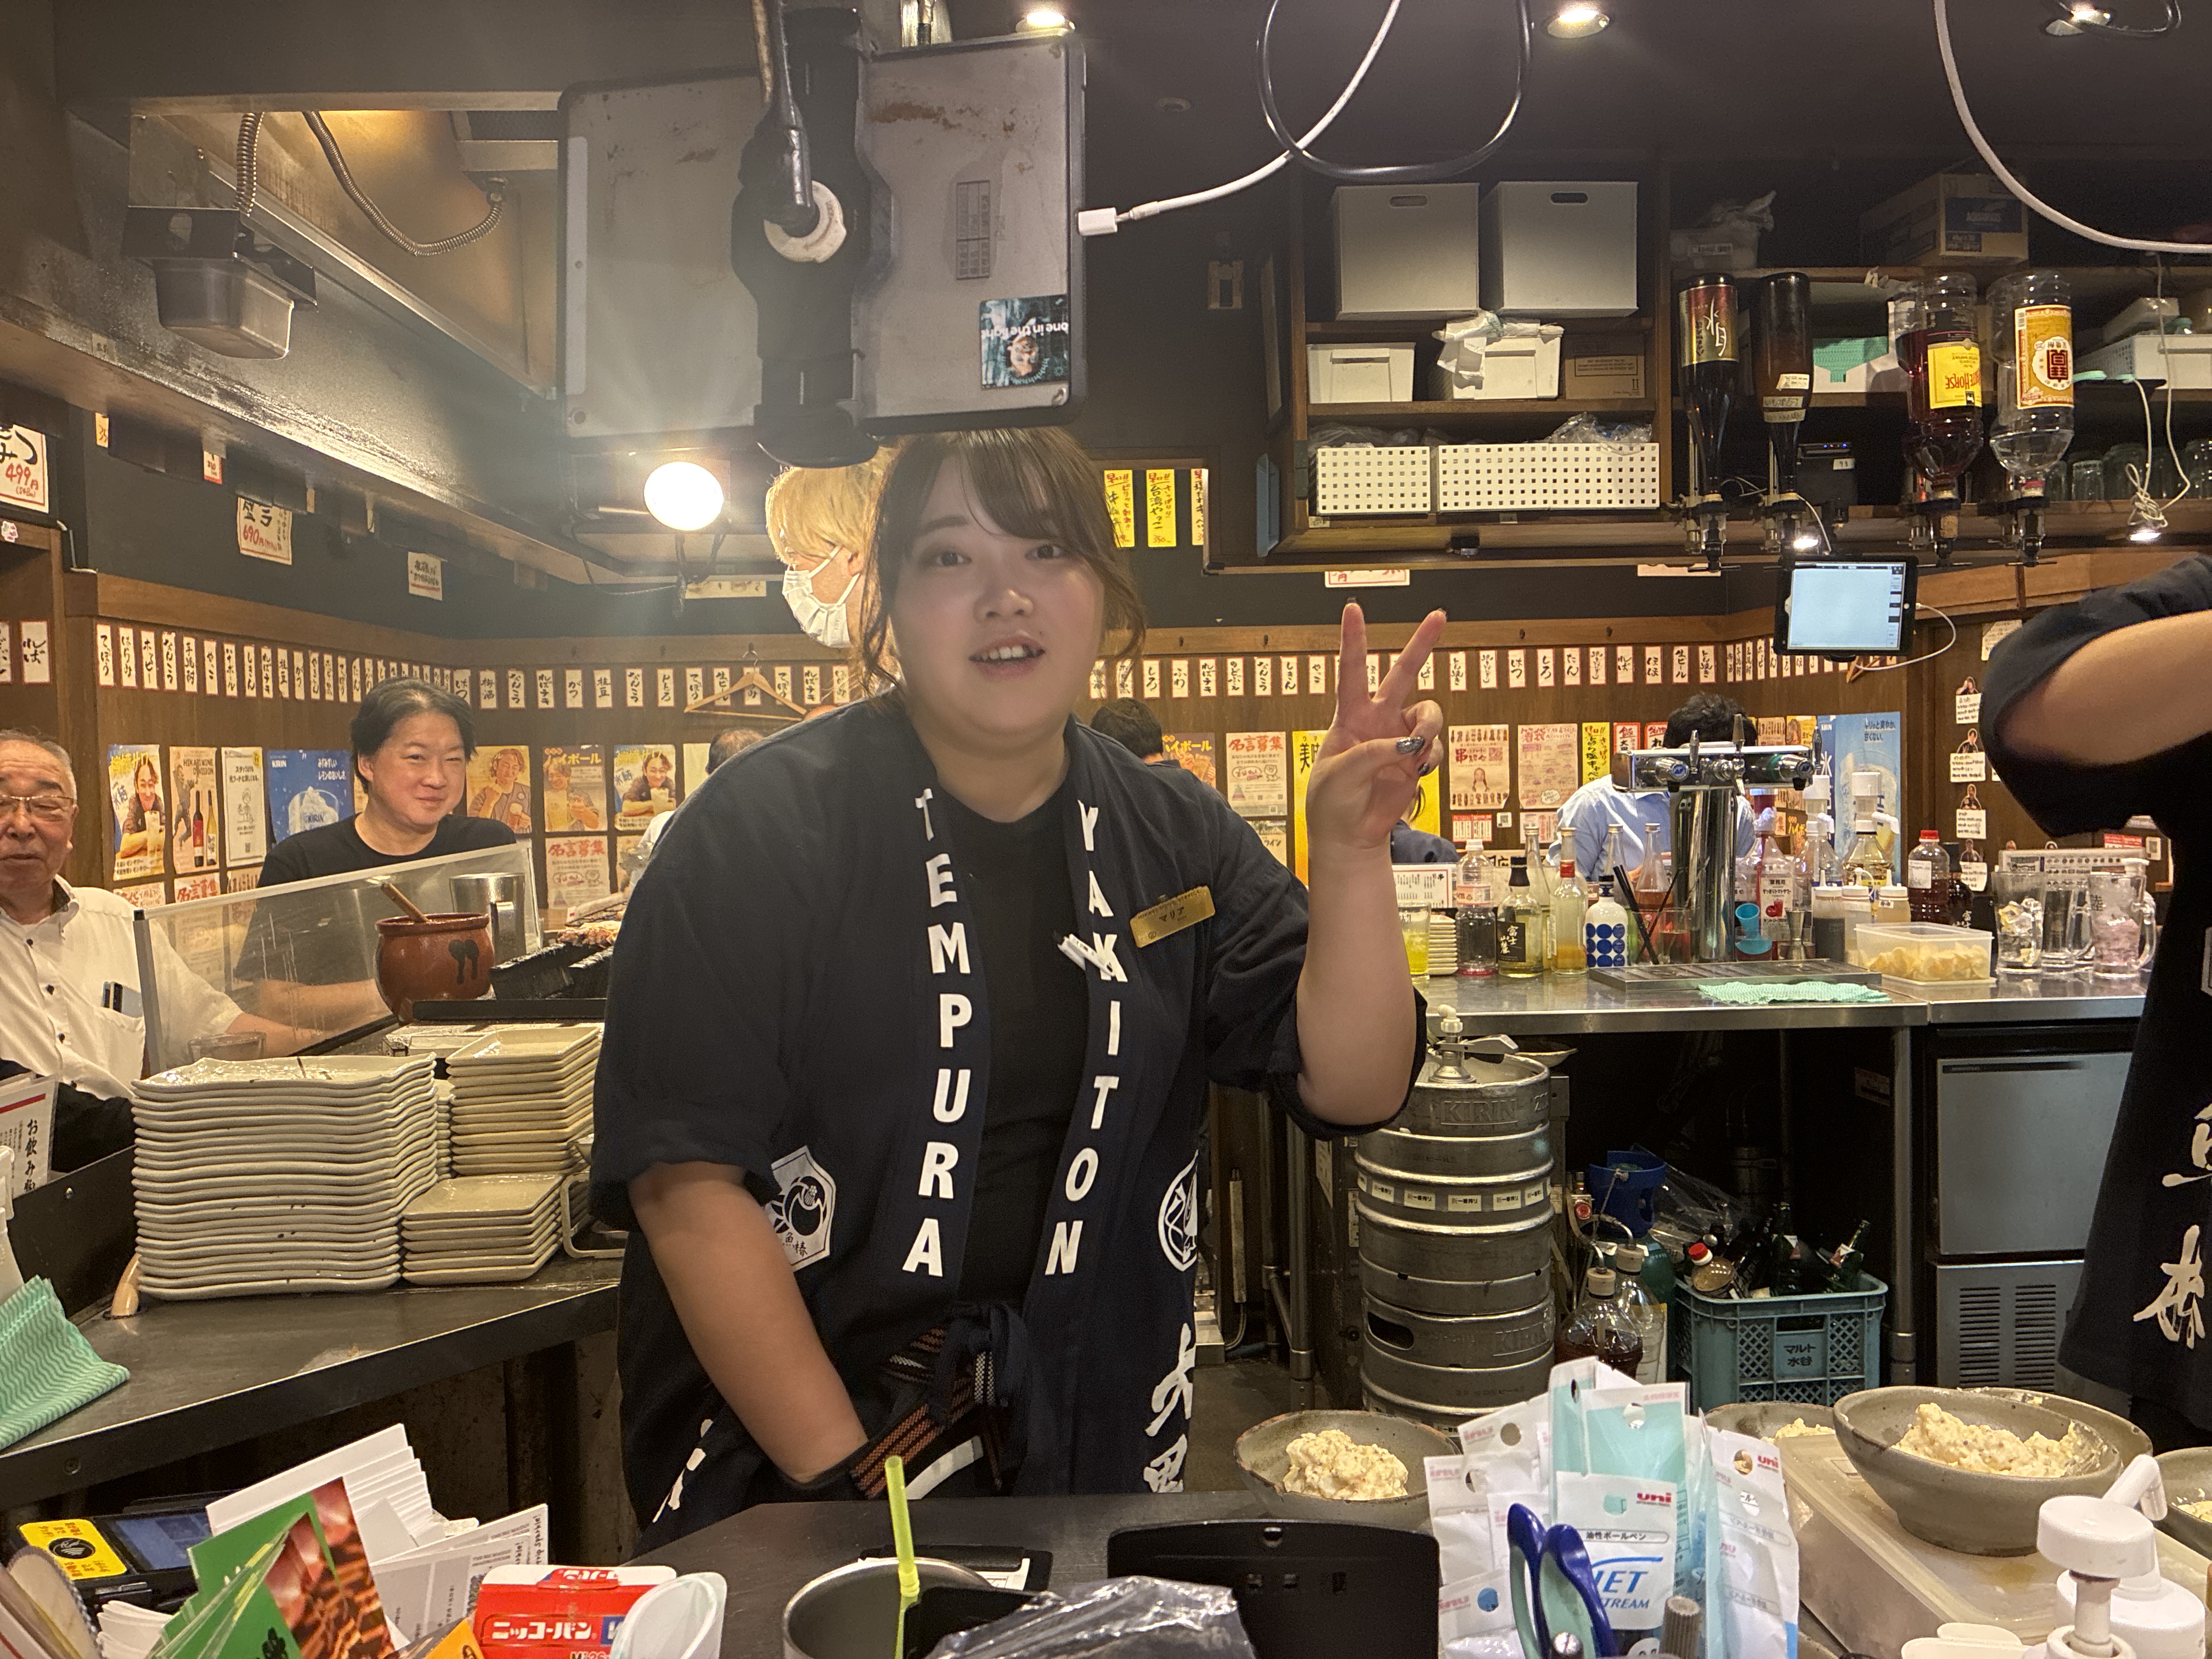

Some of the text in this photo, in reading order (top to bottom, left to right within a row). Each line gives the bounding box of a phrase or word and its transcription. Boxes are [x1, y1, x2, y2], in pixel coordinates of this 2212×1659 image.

[1944, 373, 1969, 390] HORSE
[1510, 658, 1522, 679] はつ
[1539, 656, 1552, 680] しろ
[1566, 653, 1579, 676] たん
[1675, 649, 1687, 679] 生ビール
[1228, 735, 1283, 753] 名言募集
[271, 759, 287, 768] KIRIN
[1455, 748, 1468, 763] 串
[307, 814, 324, 823] KIRIN
[549, 839, 605, 857] 名言募集
[1159, 906, 1184, 922] マリア
[1507, 925, 1519, 945] 富士
[901, 788, 973, 1278] TEMPURA
[1045, 799, 1128, 1276] YAKITON
[1444, 1099, 1517, 1122] KIRIN
[782, 1231, 808, 1257] 魚椿
[1784, 1342, 1816, 1354] マルト
[1787, 1356, 1813, 1367] 水谷
[1757, 1455, 1779, 1470] uni
[1637, 1492, 1672, 1503] uni
[1586, 1531, 1646, 1541] 油性ボールペン
[492, 1622, 592, 1640] ニッコーバン
